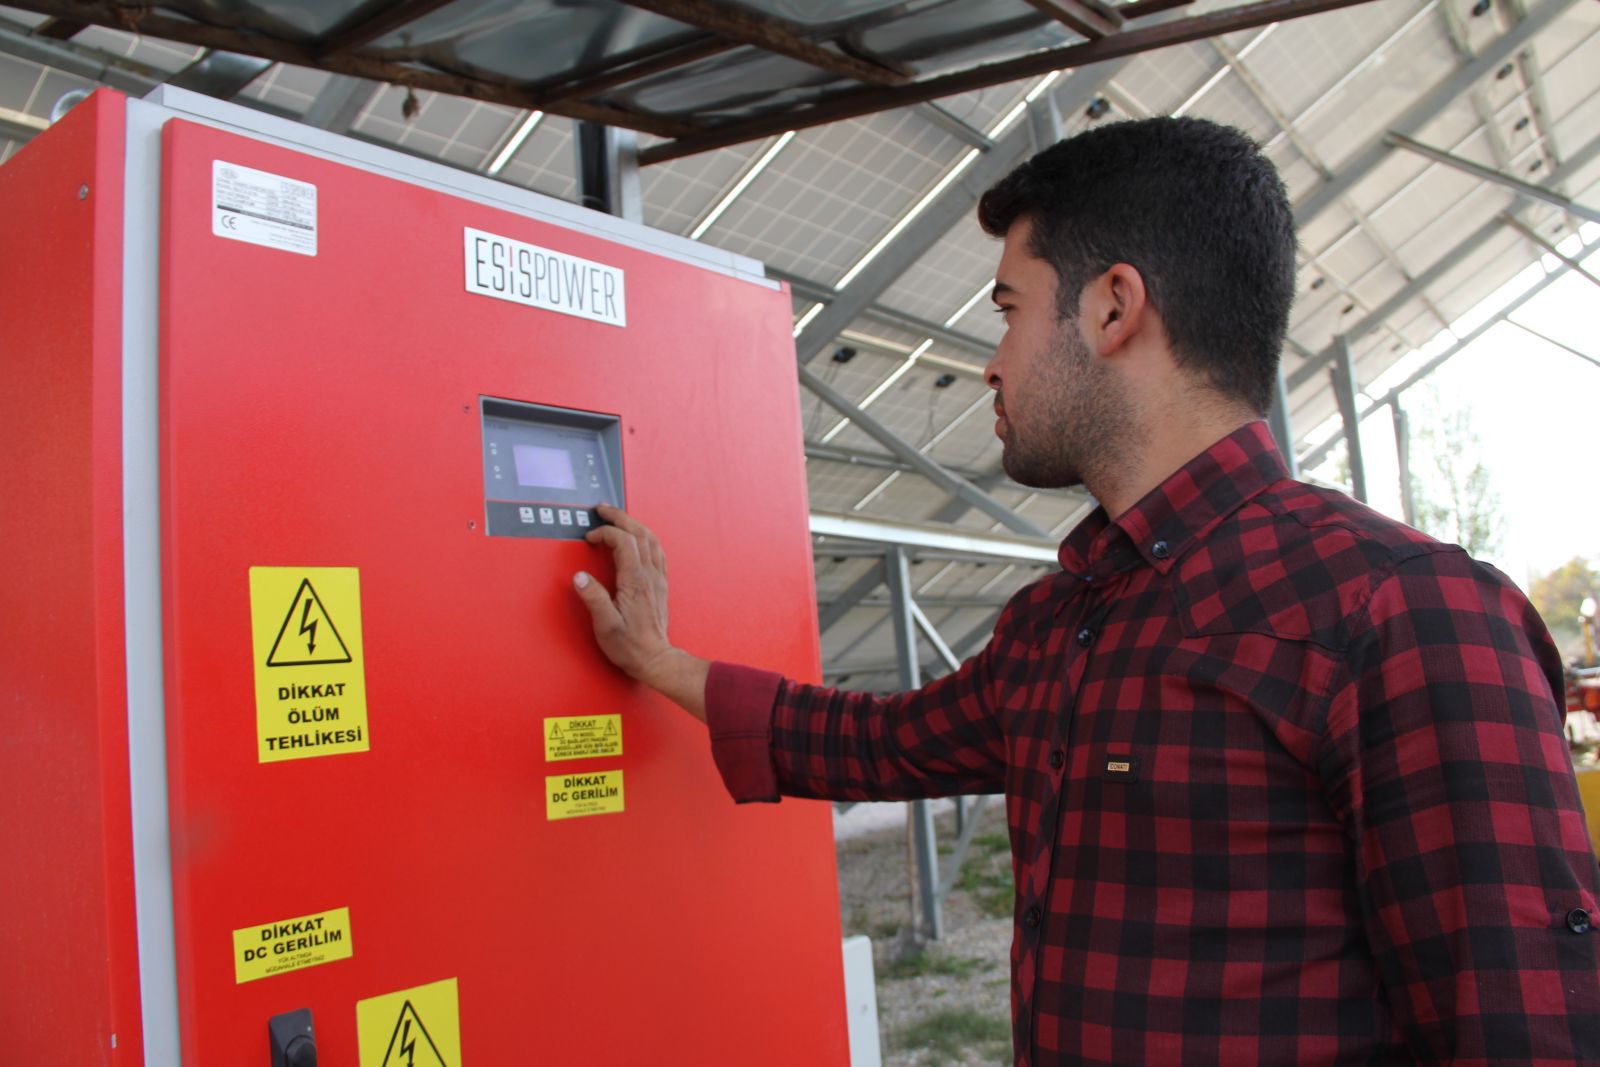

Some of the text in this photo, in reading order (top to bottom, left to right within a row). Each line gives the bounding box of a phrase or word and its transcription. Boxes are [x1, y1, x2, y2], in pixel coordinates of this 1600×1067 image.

[278, 683, 346, 701] DİKKAT
[288, 706, 340, 724] ÖLÜM
[265, 726, 362, 751] TEHLİKESİ
[564, 775, 607, 789] DİKKAT
[552, 786, 618, 803] DC GERİLİM
[261, 917, 325, 942] DİKKAT
[244, 929, 342, 962] DC GERİLİM
